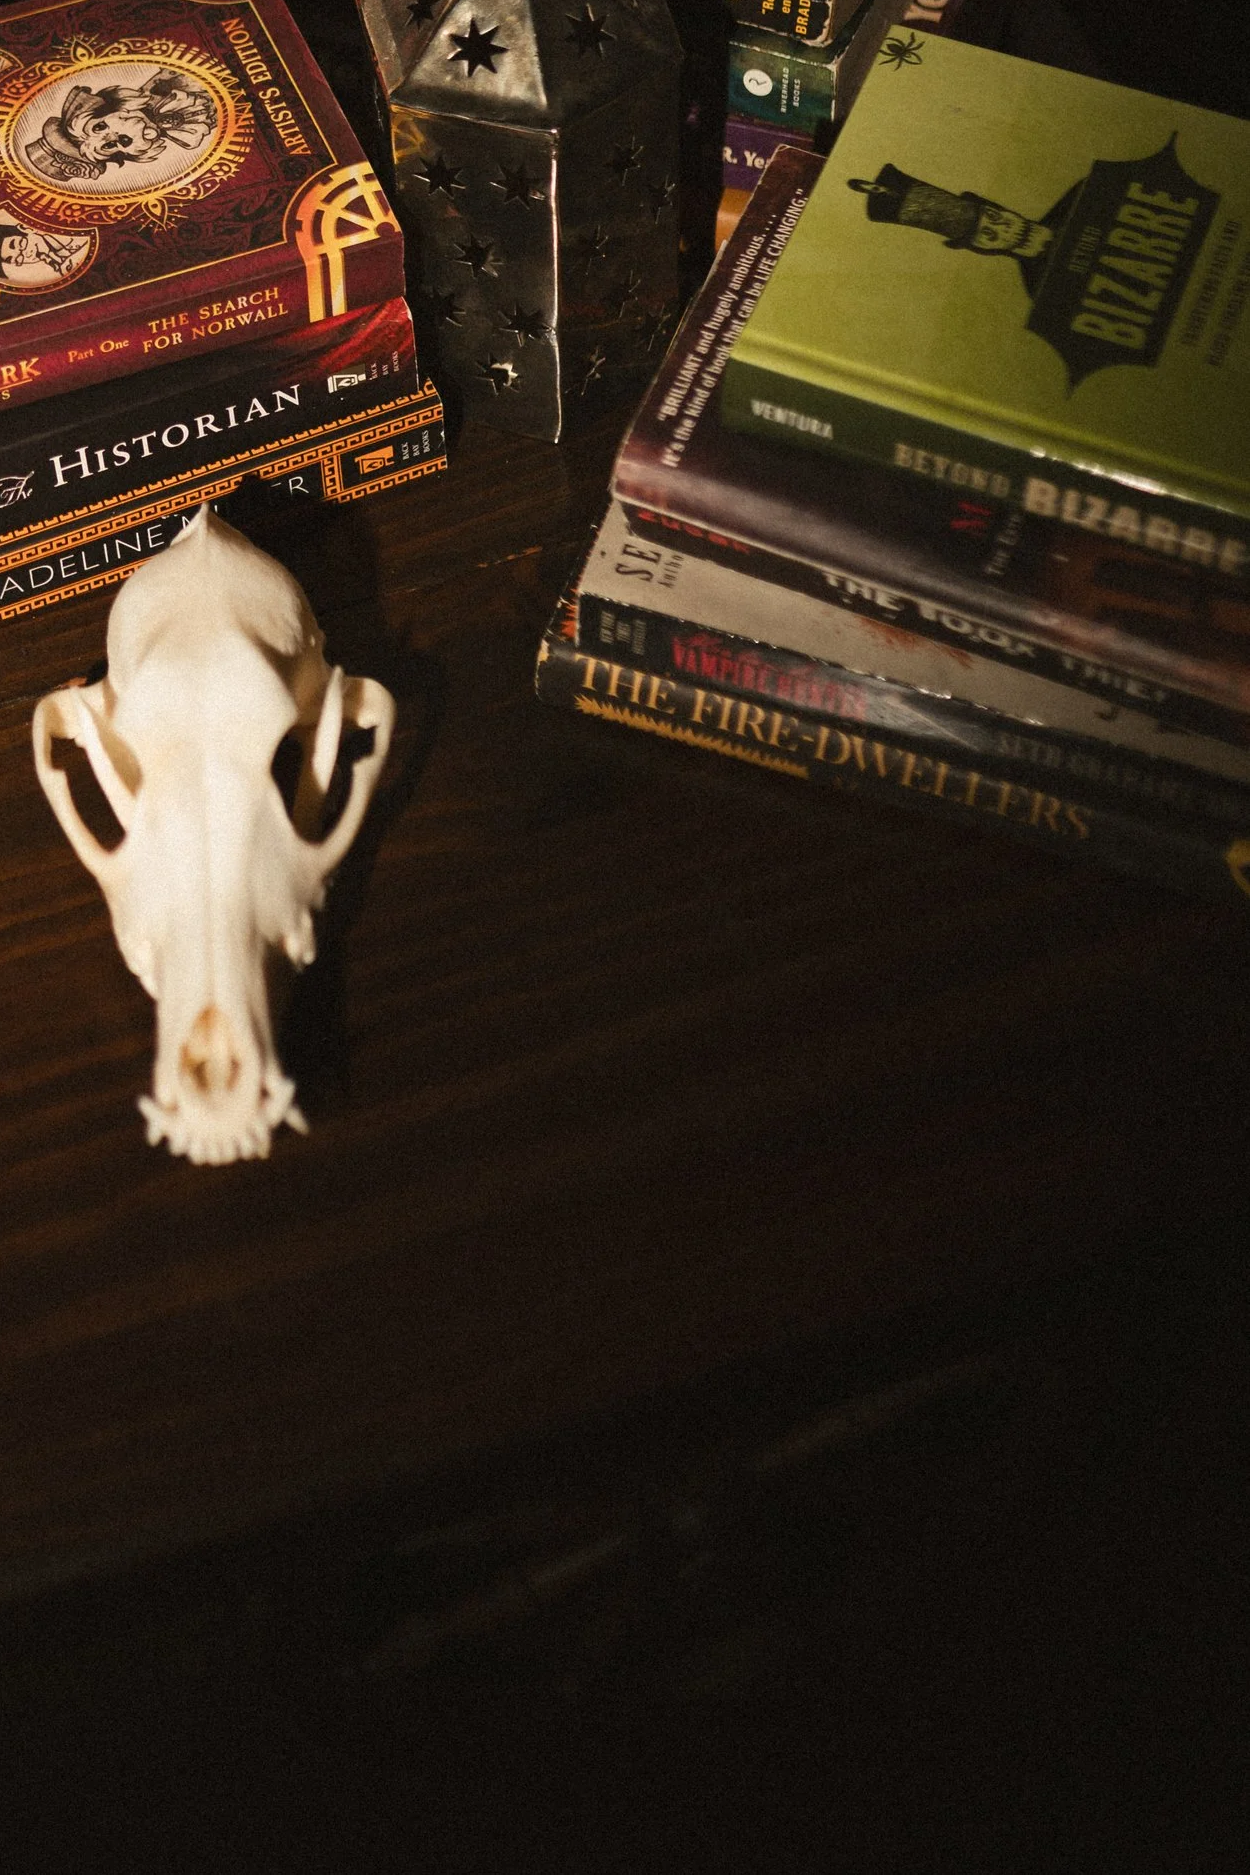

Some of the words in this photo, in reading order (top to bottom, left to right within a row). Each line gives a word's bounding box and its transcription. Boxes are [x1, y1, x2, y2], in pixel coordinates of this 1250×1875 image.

[221, 17, 272, 85] EDITION
[780, 67, 790, 113] RIVERHEAD
[793, 78, 802, 108] BOOKS
[258, 86, 312, 157] ARTIST'S
[754, 255, 777, 283] LIFE
[1070, 181, 1199, 351] BIZARRE
[746, 279, 765, 298] be
[149, 313, 190, 333] THE
[198, 286, 280, 321] SEARCH
[702, 286, 740, 334] hugely
[737, 296, 758, 320] can
[142, 332, 184, 353] FOR
[191, 302, 289, 342] NORWALL
[690, 326, 716, 355] and
[67, 348, 95, 364] Part
[99, 337, 131, 354] One
[392, 351, 400, 372] BOOKS
[706, 341, 733, 375] book
[698, 370, 718, 390] of
[683, 386, 711, 419] kind
[50, 383, 302, 488] HISTORIAN
[422, 430, 431, 454] BOOKS
[671, 415, 697, 443] the
[402, 442, 410, 461] BACK
[412, 445, 420, 457] BAY
[751, 400, 833, 440] VENTURA
[893, 443, 1012, 497] BEYOND
[1024, 477, 1247, 575] BIZARRE
[574, 653, 677, 715] THE
[692, 689, 1090, 839] FIRE-DWELLERS
